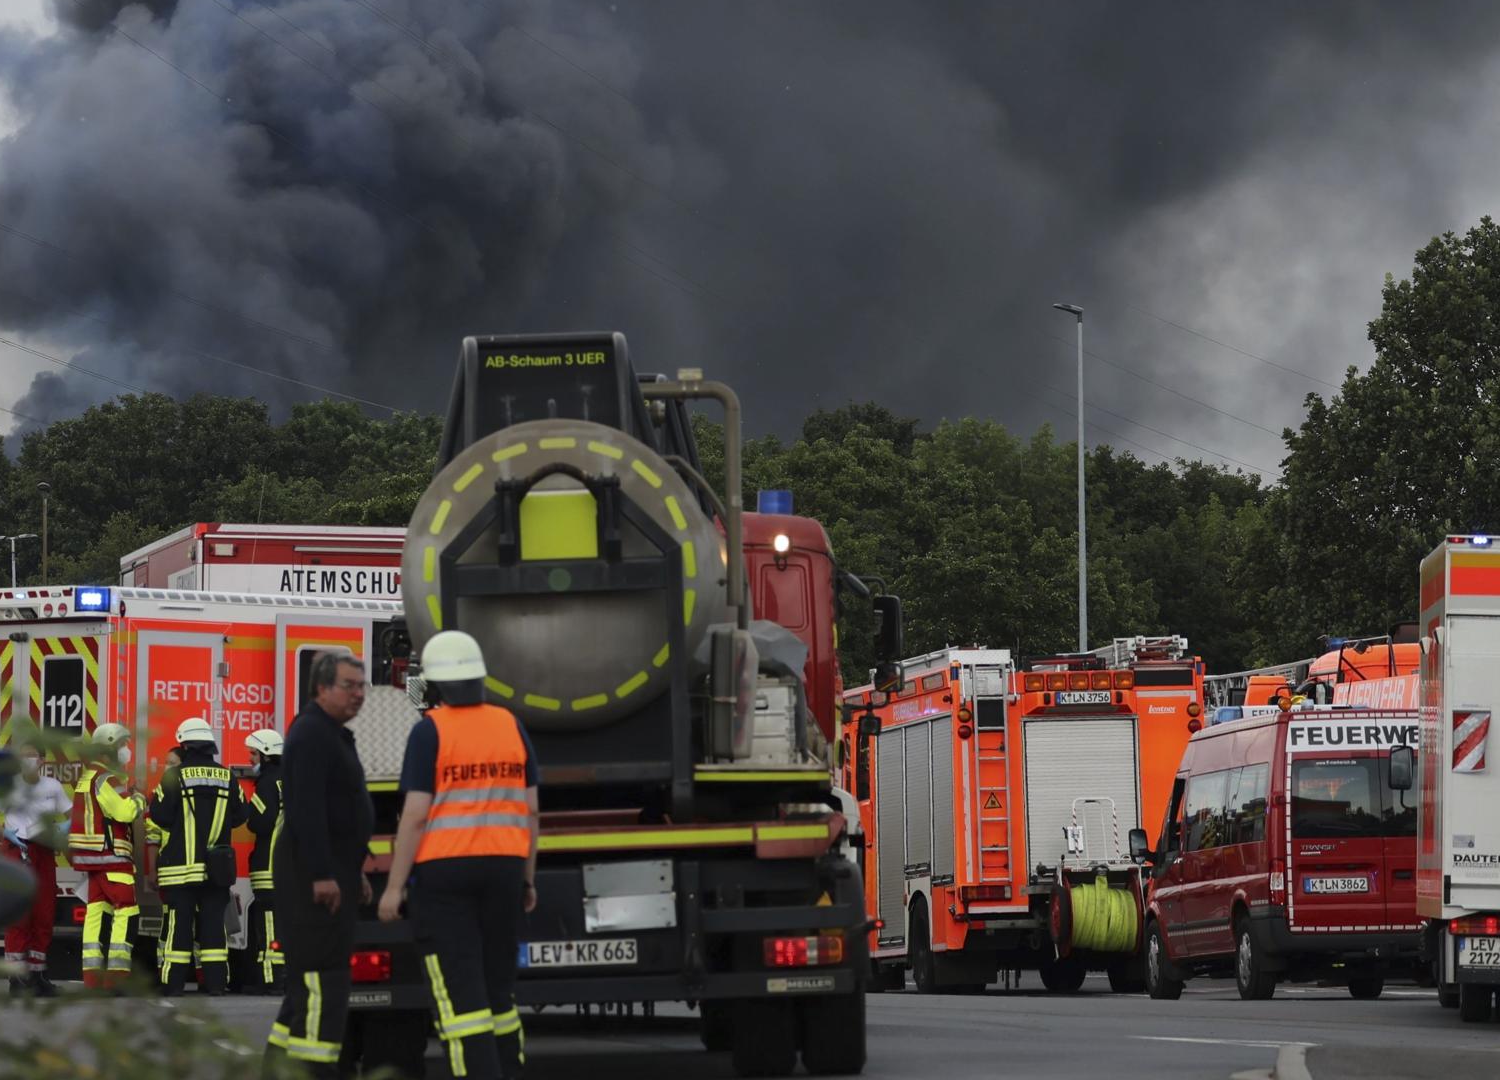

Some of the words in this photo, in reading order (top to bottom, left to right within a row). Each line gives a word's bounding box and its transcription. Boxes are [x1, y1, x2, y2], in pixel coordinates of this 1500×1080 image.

[486, 354, 562, 368] AB-Schaum
[565, 353, 574, 365] 3
[577, 352, 605, 364] UER
[280, 569, 399, 594] ATEMSCHU
[153, 680, 274, 704] RETTUNGSD
[1061, 693, 1068, 703] K
[1072, 693, 1085, 702] LN
[1087, 693, 1110, 702] 3756
[46, 694, 82, 728] 112
[181, 767, 229, 780] FEUERWEHR
[443, 761, 523, 783] FEUERWEHR
[1453, 854, 1500, 863] DAUTE
[1311, 879, 1318, 890] K
[1325, 879, 1339, 890] LN
[1340, 879, 1366, 890] 3862
[1471, 938, 1495, 951] LEV
[529, 942, 564, 965] LEV
[576, 941, 599, 963] KR
[604, 941, 636, 961] 663
[1470, 952, 1500, 965] 2172
